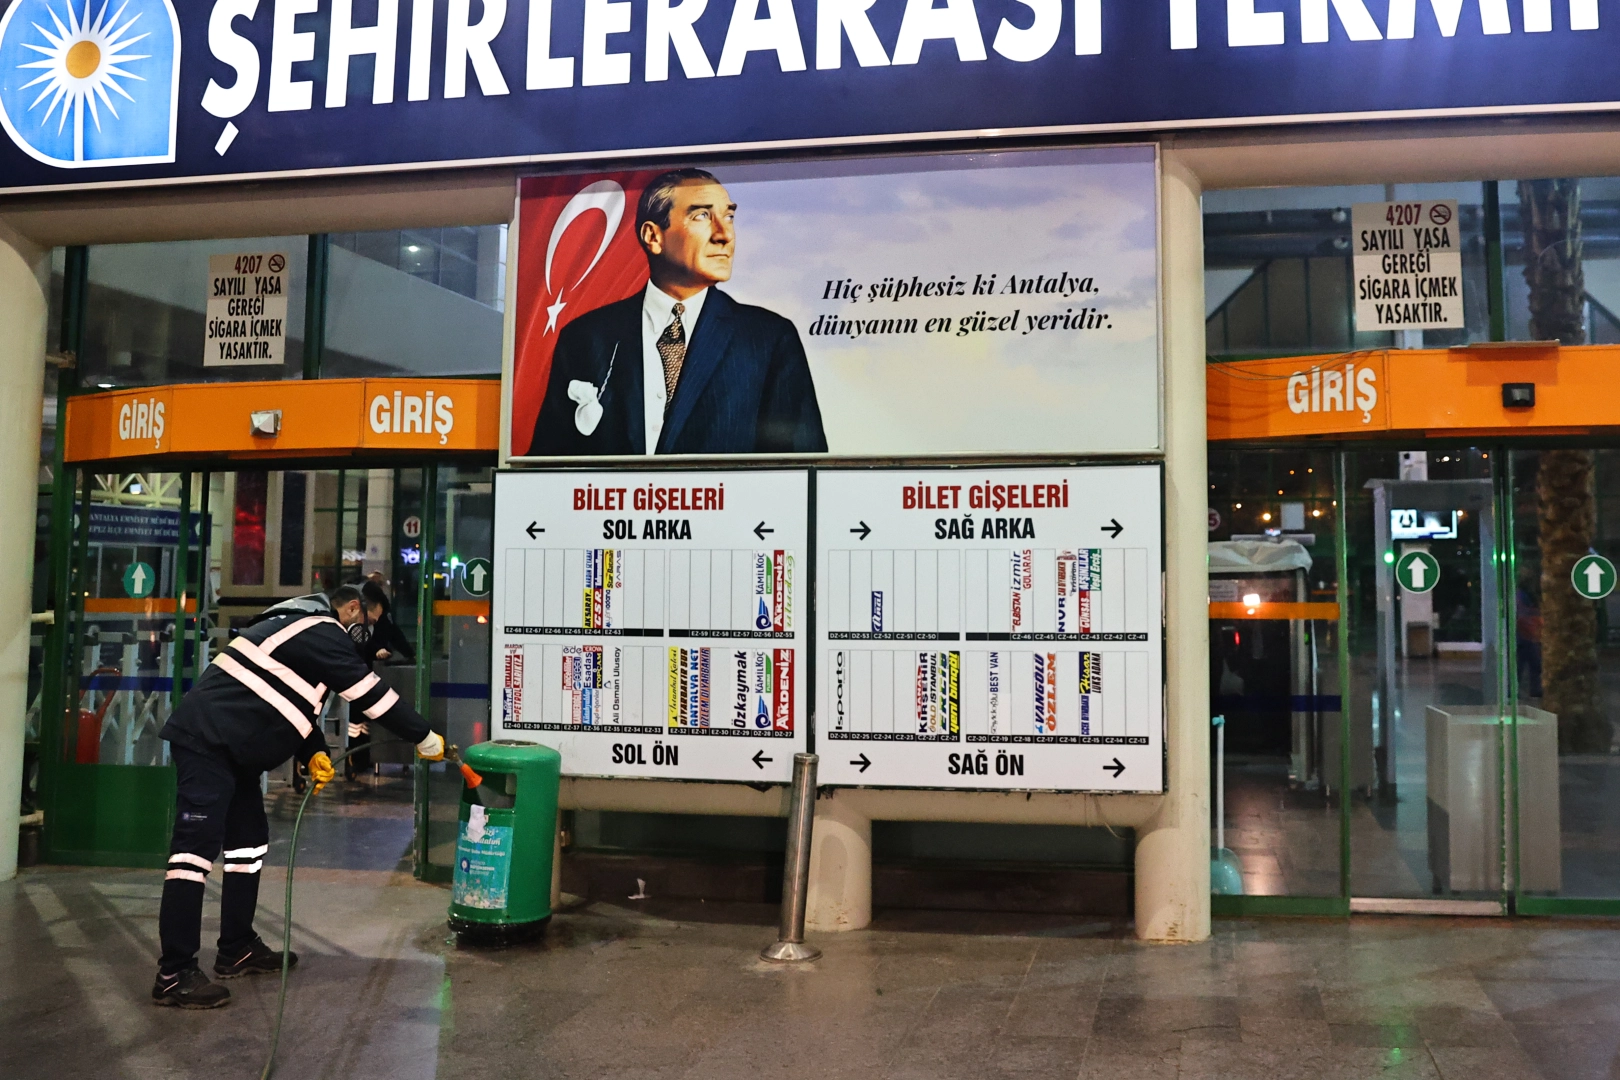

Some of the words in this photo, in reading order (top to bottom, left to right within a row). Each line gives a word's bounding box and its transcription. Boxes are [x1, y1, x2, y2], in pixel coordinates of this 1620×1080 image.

[1386, 204, 1421, 225] 4207
[1361, 229, 1404, 251] SAYILI
[1414, 227, 1450, 249] YASA
[235, 256, 262, 274] 4207
[1382, 248, 1430, 274] GEREĞİ
[214, 277, 245, 296] SAYILI
[255, 276, 281, 295] YASA
[822, 279, 862, 303] Hiç
[868, 276, 966, 302] şüphesiz
[972, 274, 996, 295] ki
[1000, 272, 1099, 297] Antalya,
[1360, 275, 1410, 300] SİGARA
[1415, 274, 1457, 301] İÇMEK
[228, 294, 264, 316] GEREĞİ
[1375, 302, 1447, 324] YASAKTIR.
[209, 317, 246, 338] SİGARA
[250, 316, 282, 340] İÇMEK
[809, 315, 917, 339] dünyanın
[925, 317, 951, 332] en
[957, 309, 1020, 336] güzel
[1022, 308, 1112, 335] yeridir.
[220, 341, 272, 359] YASAKTIR.
[1287, 364, 1377, 423] GİRİŞ
[118, 398, 164, 449] GİRİŞ
[370, 391, 453, 445] GİRİŞ
[573, 484, 626, 510] BİLET
[633, 483, 724, 513] GİŞELERİ
[903, 481, 961, 509] BİLET
[969, 479, 1068, 512] GİŞELERİ
[406, 521, 418, 533] 11
[603, 519, 636, 540] SOL
[643, 520, 691, 540] ARKA
[935, 514, 974, 539] SAĞ
[982, 517, 1035, 539] ARKA
[1011, 551, 1021, 590] izmir
[774, 554, 784, 626] AKDENİZ
[690, 649, 698, 670] NET
[990, 652, 998, 668] VAN
[1091, 653, 1101, 676] ADANA
[990, 671, 998, 692] BEST
[1080, 653, 1090, 693] Hisar
[690, 675, 698, 726] ANTALYA
[731, 650, 749, 728] Özkaymak
[776, 650, 791, 729] AKDENİZ
[836, 652, 845, 730] Isparta
[1034, 653, 1044, 723] VANGÖLÜ
[1046, 652, 1056, 731] ÖZLEM
[612, 743, 646, 765] SOL
[653, 741, 678, 765] ÖN
[948, 750, 988, 775] SAĞ
[996, 750, 1024, 775] ÖN
